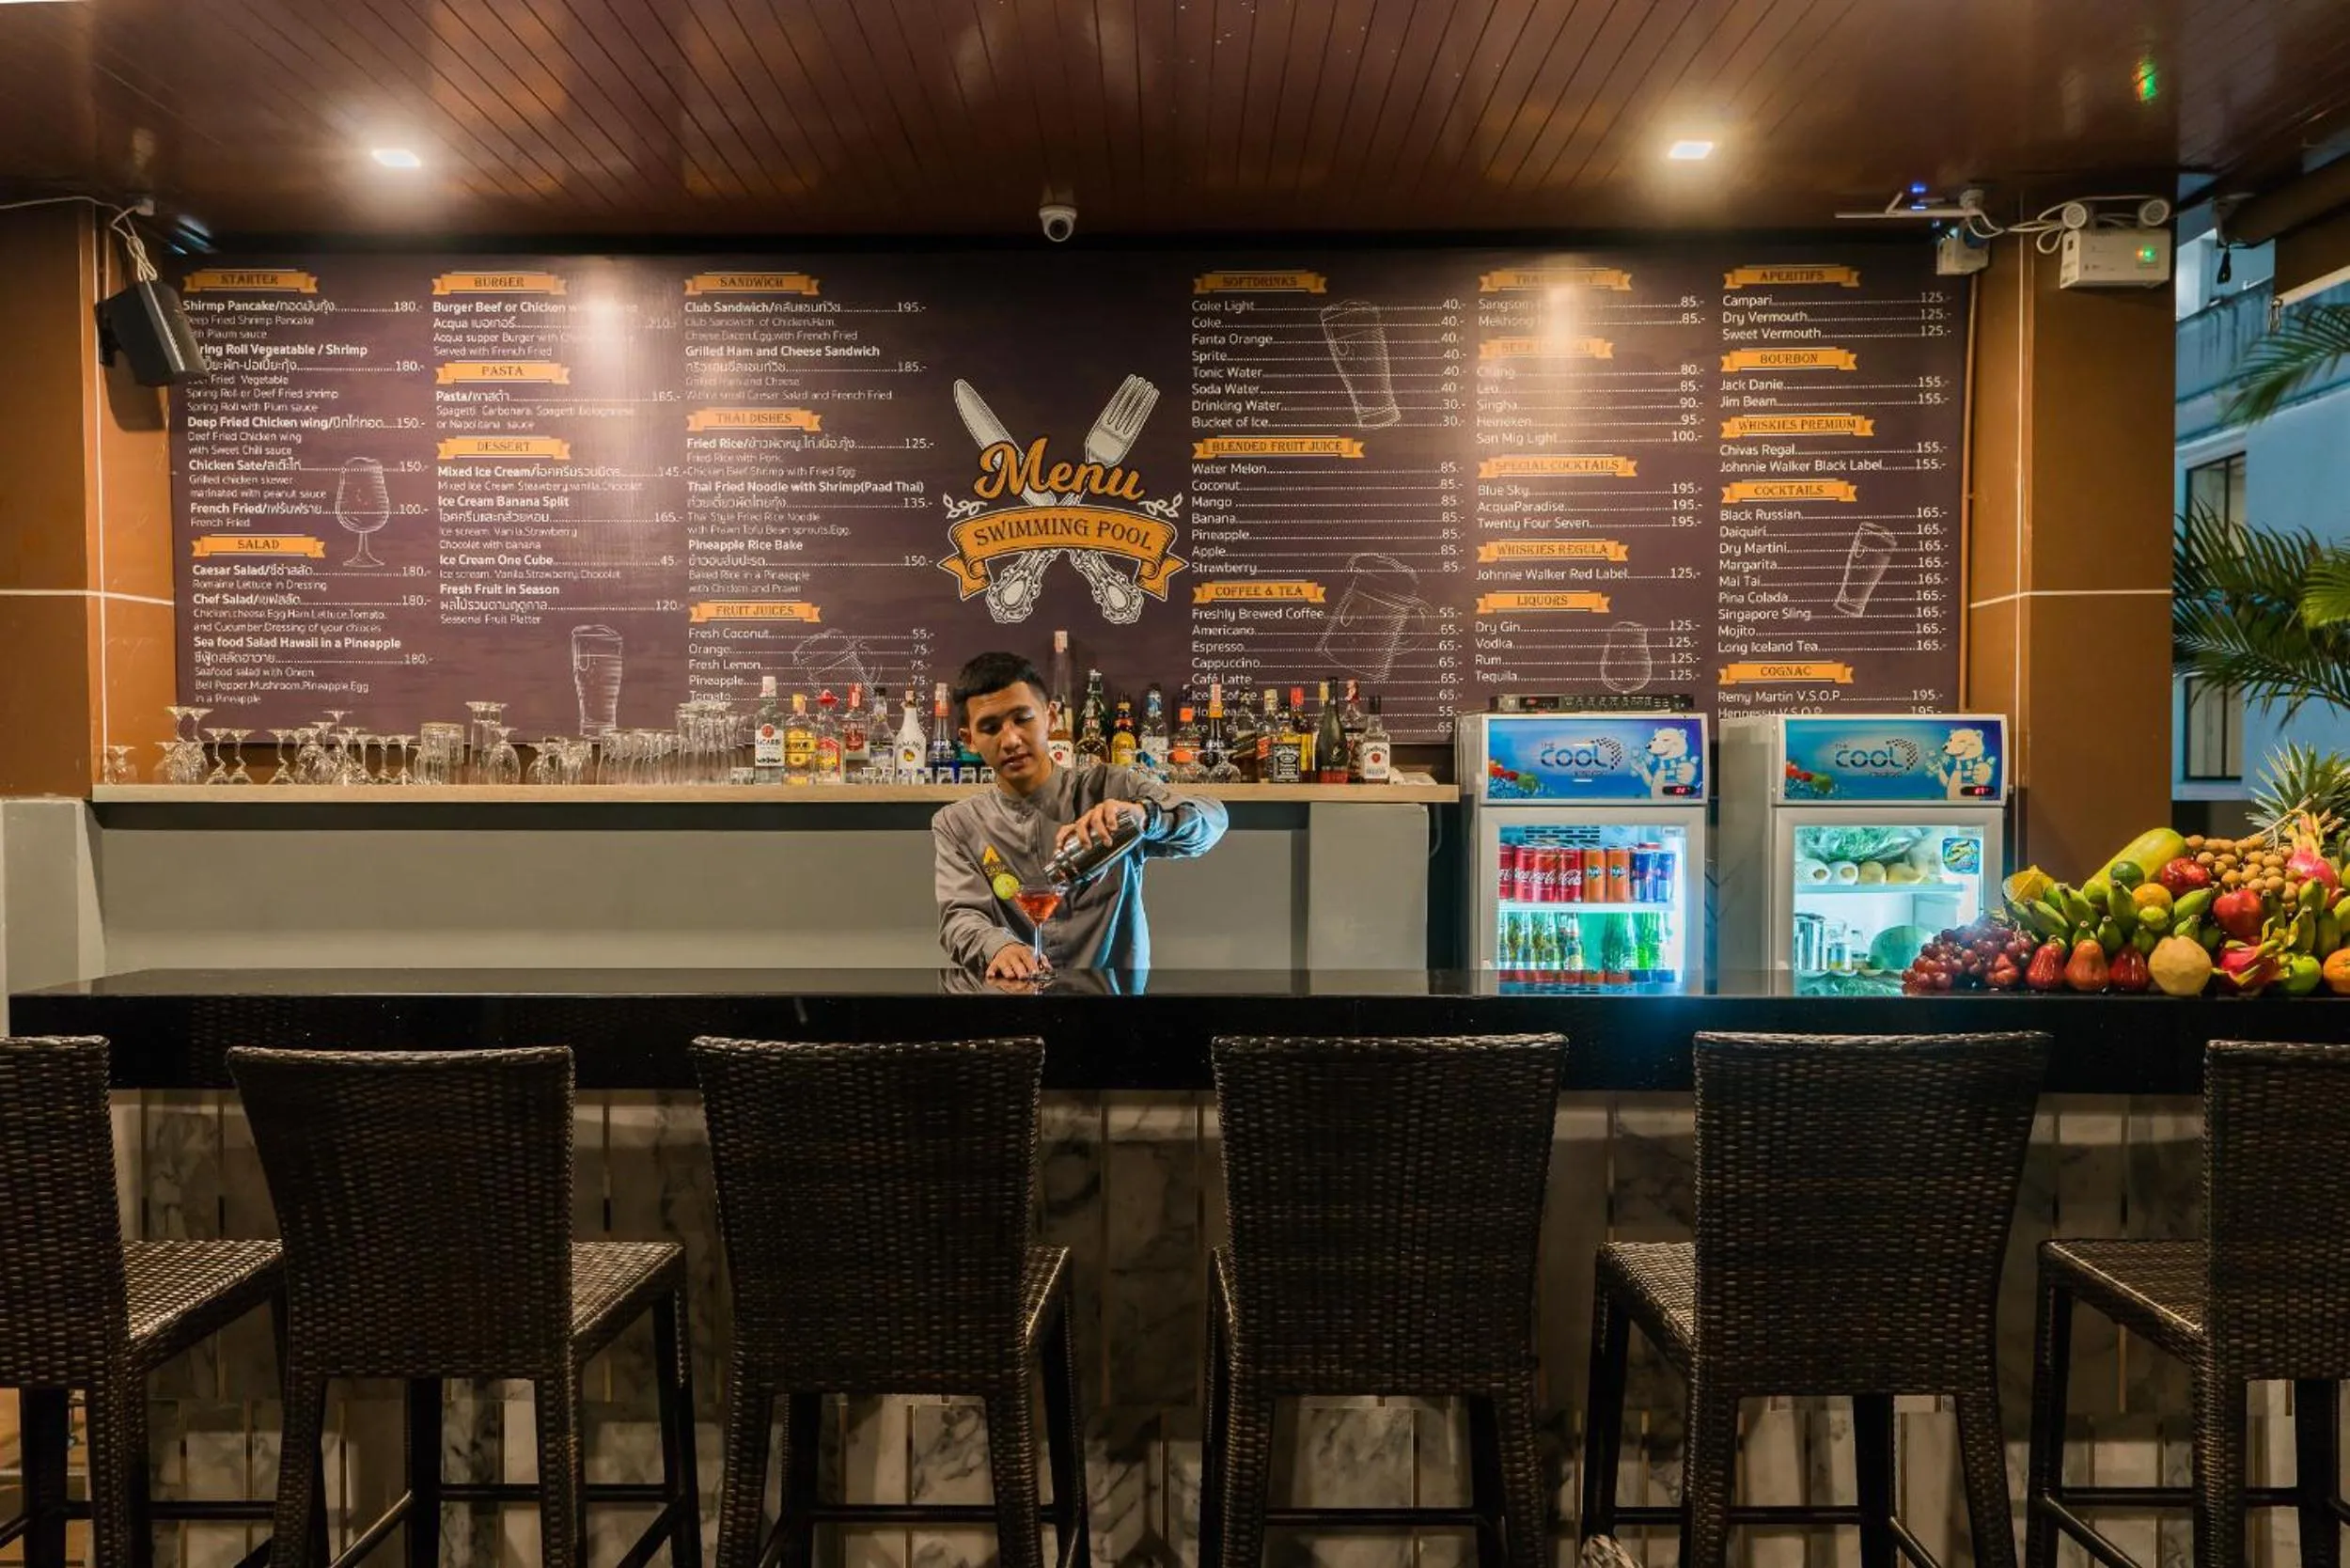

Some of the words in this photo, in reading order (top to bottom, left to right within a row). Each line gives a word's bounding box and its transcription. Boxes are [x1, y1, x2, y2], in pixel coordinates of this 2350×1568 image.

[221, 275, 278, 285] STARTER
[1760, 272, 1825, 280] APERITIFS
[474, 277, 525, 287] BURGER
[720, 277, 784, 287] SANDWICH
[1723, 295, 1772, 307] Campari
[433, 302, 473, 314] Burger
[476, 302, 502, 312] Beef
[520, 302, 565, 312] Chicken
[685, 302, 712, 312] Club
[1225, 301, 1254, 314] Light
[1748, 312, 1808, 322] Vermouth
[1723, 329, 1758, 339] Sweet
[1762, 328, 1822, 339] Vermouth
[1192, 335, 1225, 344] Fanta
[1230, 335, 1272, 347] Orange
[685, 346, 723, 356] Grilled
[780, 346, 822, 356] Cheese
[824, 345, 880, 356] Sandwich
[1192, 351, 1227, 363] Sprite
[1760, 354, 1818, 363] BOURBON
[481, 367, 524, 376] PASTA
[1192, 368, 1223, 378] Tonic
[1227, 368, 1261, 378] Water
[1192, 384, 1221, 395] Soda
[1225, 384, 1259, 395] Water
[1720, 380, 1747, 391] Jack
[1192, 400, 1243, 414] Drinking
[1246, 400, 1281, 411] Water
[1720, 397, 1739, 408] Jim
[1744, 396, 1777, 406] Beam
[220, 417, 249, 428] Fried
[253, 417, 297, 428] Chicken
[751, 414, 791, 422] DISHES
[1192, 417, 1232, 429] Bucket
[1739, 420, 1796, 431] WHISKIES
[1801, 419, 1856, 429] PREMIUM
[687, 438, 716, 448] Fried
[1528, 432, 1558, 446] Light
[477, 443, 531, 451] DESSERT
[1212, 441, 1268, 451] BLENDED
[1272, 441, 1306, 451] FRUIT
[1308, 441, 1341, 451] JUICE
[1720, 445, 1758, 456] Chivas
[1762, 444, 1795, 456] Regal
[189, 461, 234, 471] Chicken
[974, 437, 1145, 500] Menu
[1192, 463, 1227, 474] Water
[1230, 463, 1267, 474] Melon
[1496, 460, 1543, 469] SPECIAL
[1553, 460, 1619, 469] COCKTAILS
[1720, 462, 1766, 473] Johnnie
[1770, 462, 1810, 472] Walker
[1815, 461, 1846, 471] Black
[1850, 461, 1883, 471] Label
[438, 466, 473, 477] Mixed
[688, 481, 712, 492] Thai
[715, 481, 744, 492] Fried
[748, 481, 789, 492] Noodle
[791, 481, 815, 492] with
[1192, 480, 1240, 491] Coconut
[1479, 485, 1503, 495] Blue
[1754, 485, 1824, 495] COCKTAILS
[457, 496, 494, 507] Cream
[496, 496, 540, 507] Banana
[542, 496, 570, 508] Split
[1192, 497, 1231, 510] Mango
[1478, 501, 1564, 513] AcquaParadise
[191, 503, 231, 513] French
[1192, 513, 1236, 524] Banana
[1720, 510, 1752, 521] Black
[1756, 510, 1801, 520] Russian
[1478, 518, 1520, 531] Twenty
[1524, 518, 1551, 527] Four
[1555, 518, 1590, 527] Seven
[974, 518, 1089, 545] SWIMMING
[1097, 521, 1152, 550] POOL
[1192, 529, 1249, 541] Pineapple
[1719, 526, 1767, 538] Daiquiri
[238, 541, 280, 549] SALAD
[689, 540, 745, 551] Pineapple
[748, 540, 772, 550] Rice
[775, 540, 803, 550] Bake
[1497, 544, 1555, 555] WHISKIES
[1559, 544, 1607, 554] REGULA
[1719, 543, 1741, 556] Dry
[1745, 542, 1787, 553] Martini
[1192, 546, 1226, 559] Apple
[459, 555, 495, 565] Cream
[193, 565, 230, 575] Caesar
[1192, 563, 1257, 576] Strawberry
[1719, 560, 1777, 572] Margarita
[1477, 570, 1523, 580] Johnnie
[1526, 569, 1567, 580] Walker
[1570, 569, 1591, 579] Red
[1596, 569, 1628, 579] Label
[440, 585, 472, 594] Fresh
[475, 585, 502, 594] Fruit
[519, 585, 559, 594] Season
[1214, 587, 1261, 596] COFFEE
[1278, 587, 1302, 596] TEA
[194, 595, 220, 604] Chef
[1517, 595, 1568, 605] LIQUORS
[1747, 593, 1788, 604] Colada
[716, 606, 748, 615] FRUIT
[753, 606, 794, 616] JUICES
[1192, 608, 1236, 622] Freshly
[1239, 609, 1282, 619] Brewed
[1285, 608, 1324, 619] Coffee
[1718, 609, 1778, 621] Singapore
[1782, 608, 1811, 621] Sling
[689, 628, 719, 638] Fresh
[723, 628, 768, 638] Coconut
[1192, 625, 1254, 635] Americano
[1718, 626, 1756, 638] Mojito
[217, 637, 243, 647] food
[246, 637, 277, 647] Salad
[344, 637, 401, 650] Pineapple
[1192, 642, 1245, 654] Espresso
[1476, 638, 1512, 648] Vodka
[1718, 643, 1747, 655] Long
[1751, 641, 1793, 652] Iceland
[1797, 641, 1818, 651] Tea
[689, 644, 730, 655] Orange
[689, 660, 719, 669] Fresh
[723, 660, 760, 669] Lemon
[1192, 658, 1260, 671] Cappuccino
[1476, 655, 1501, 665] Rum
[1760, 666, 1812, 676] COGNAC
[690, 677, 744, 688] Pineapple
[1222, 674, 1252, 684] Latte
[1476, 671, 1517, 683] Tequila
[1756, 691, 1793, 702] Martin
